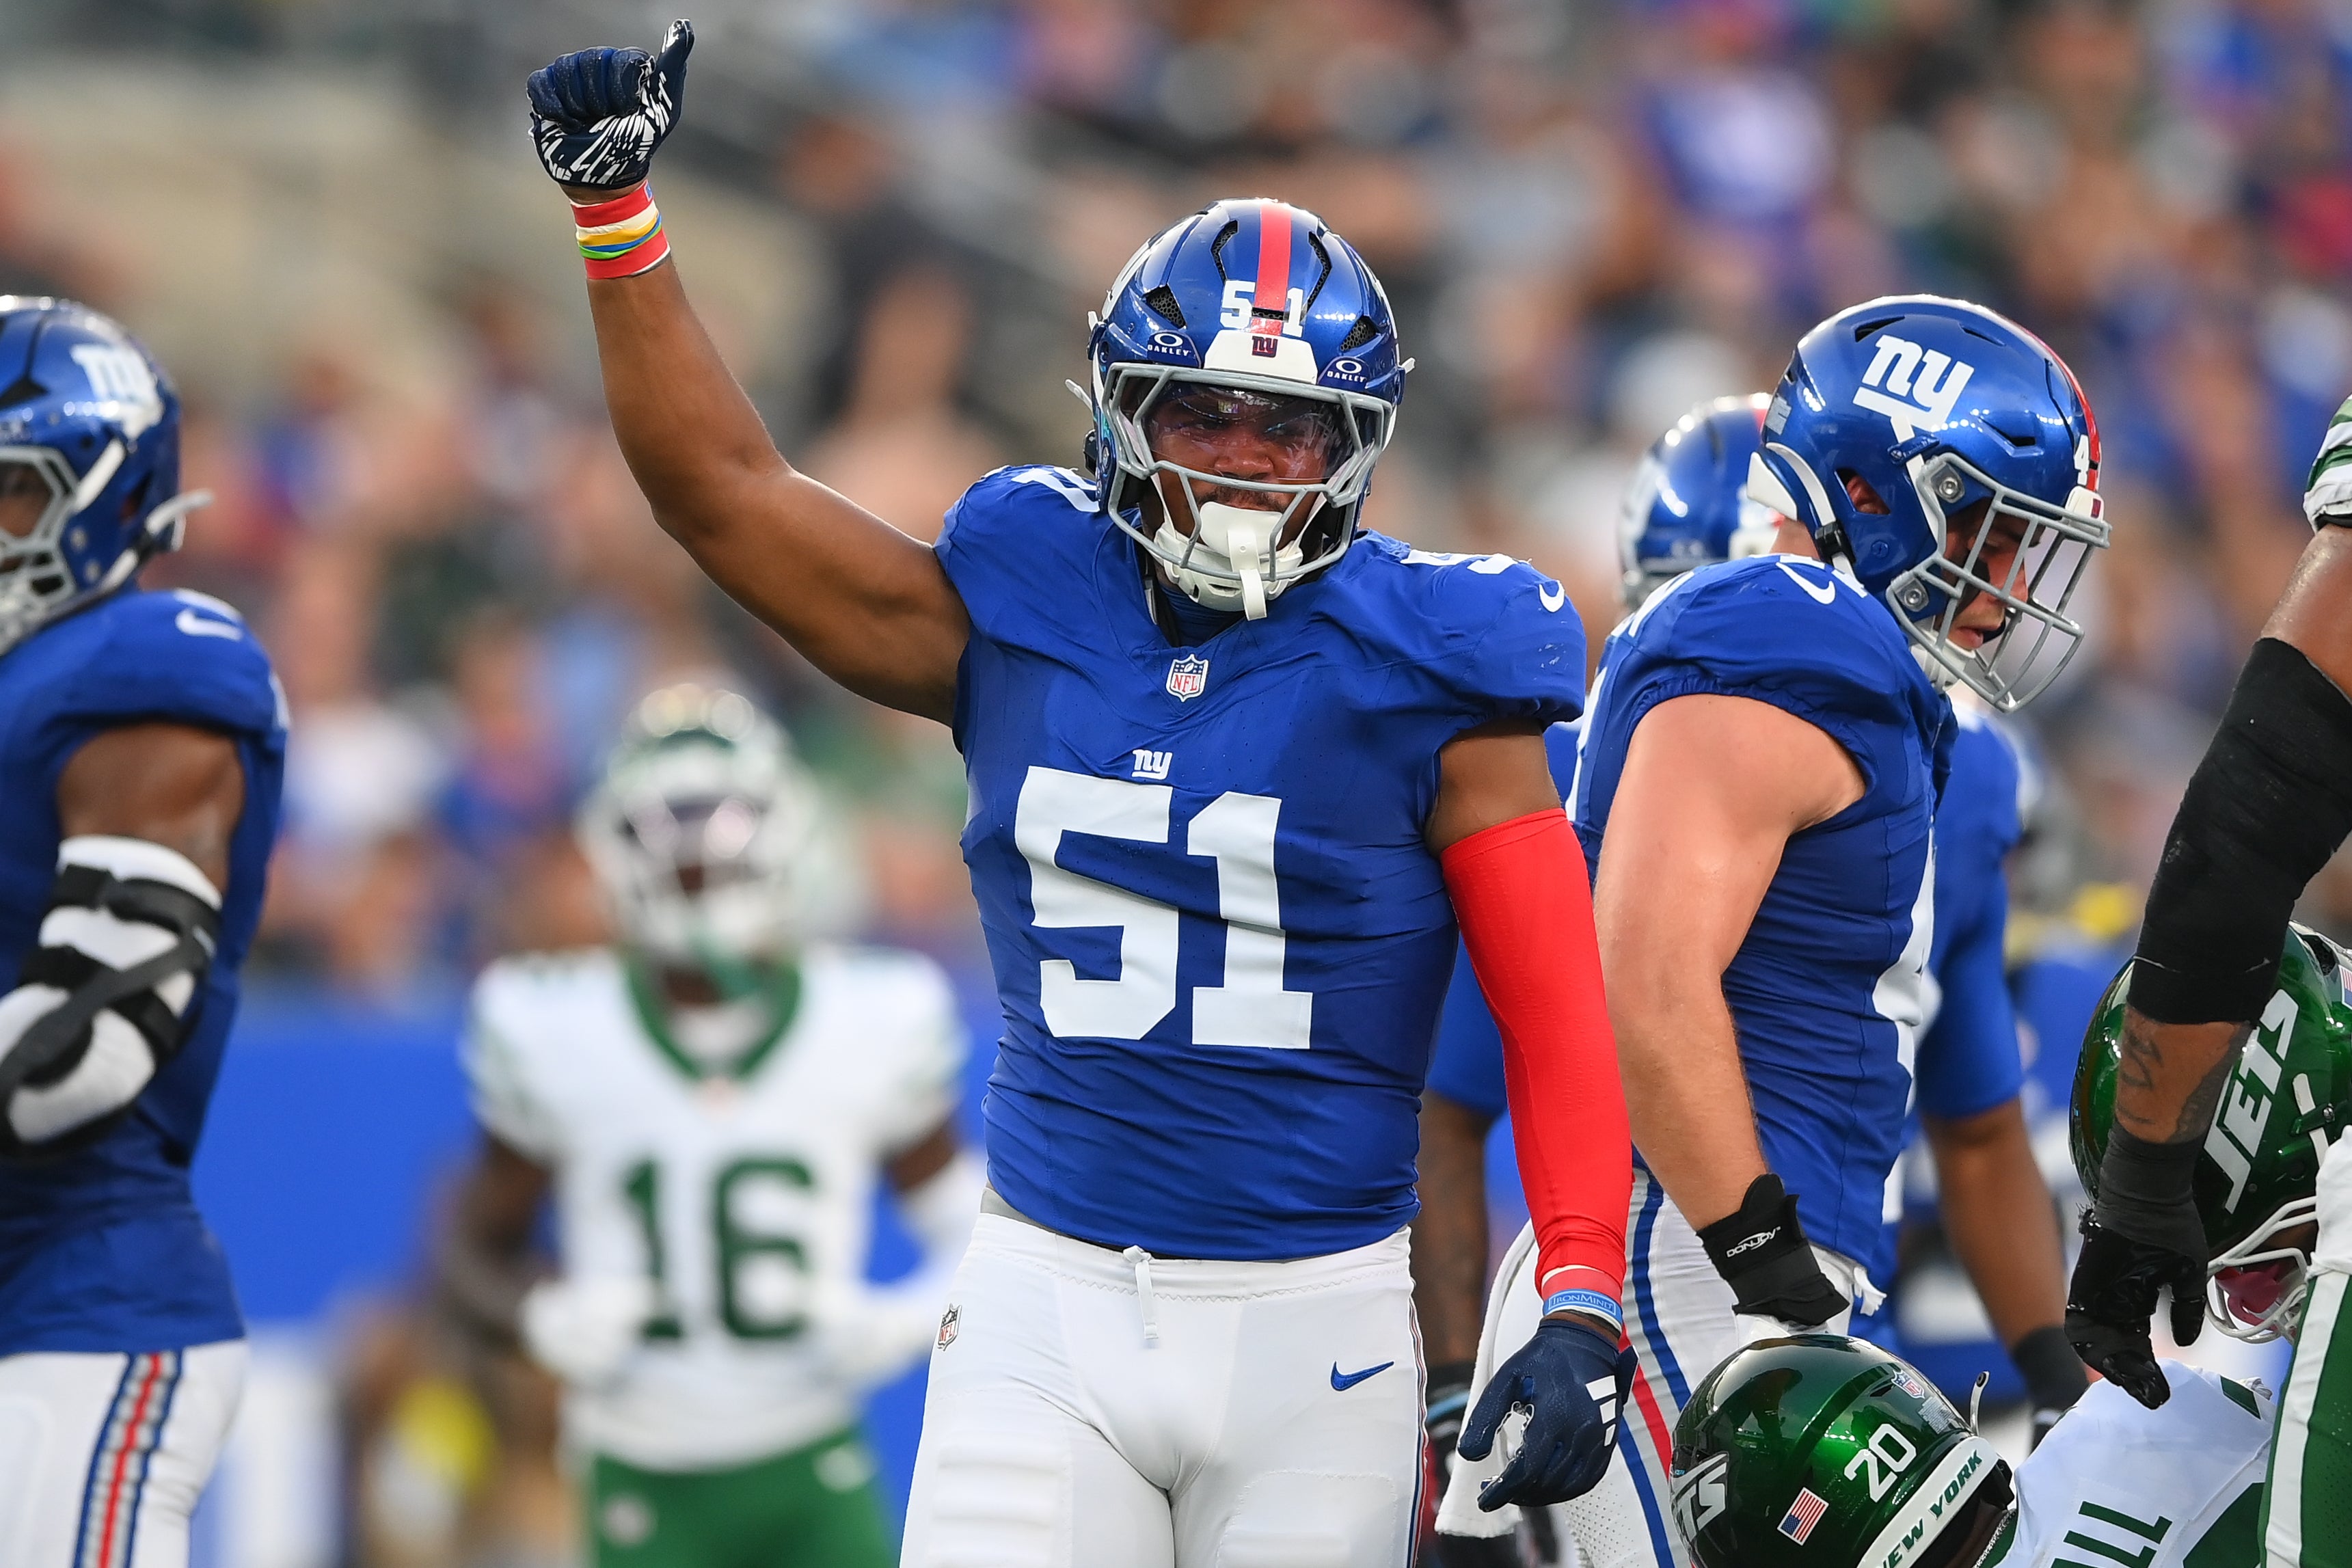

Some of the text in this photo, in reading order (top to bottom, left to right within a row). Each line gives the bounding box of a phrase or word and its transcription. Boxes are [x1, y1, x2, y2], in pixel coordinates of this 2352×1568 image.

[1220, 280, 1303, 337] 51
[1148, 344, 1189, 357] OAKLEY
[1327, 371, 1365, 383] OAKLEY
[1172, 674, 1198, 692] NFL
[1014, 766, 1312, 1049] 51
[621, 1155, 816, 1342] 16
[1727, 1229, 1776, 1258] DONJOY
[940, 1323, 954, 1342] NFL
[1843, 1423, 1917, 1502] 20
[1930, 1449, 1982, 1521] YORK
